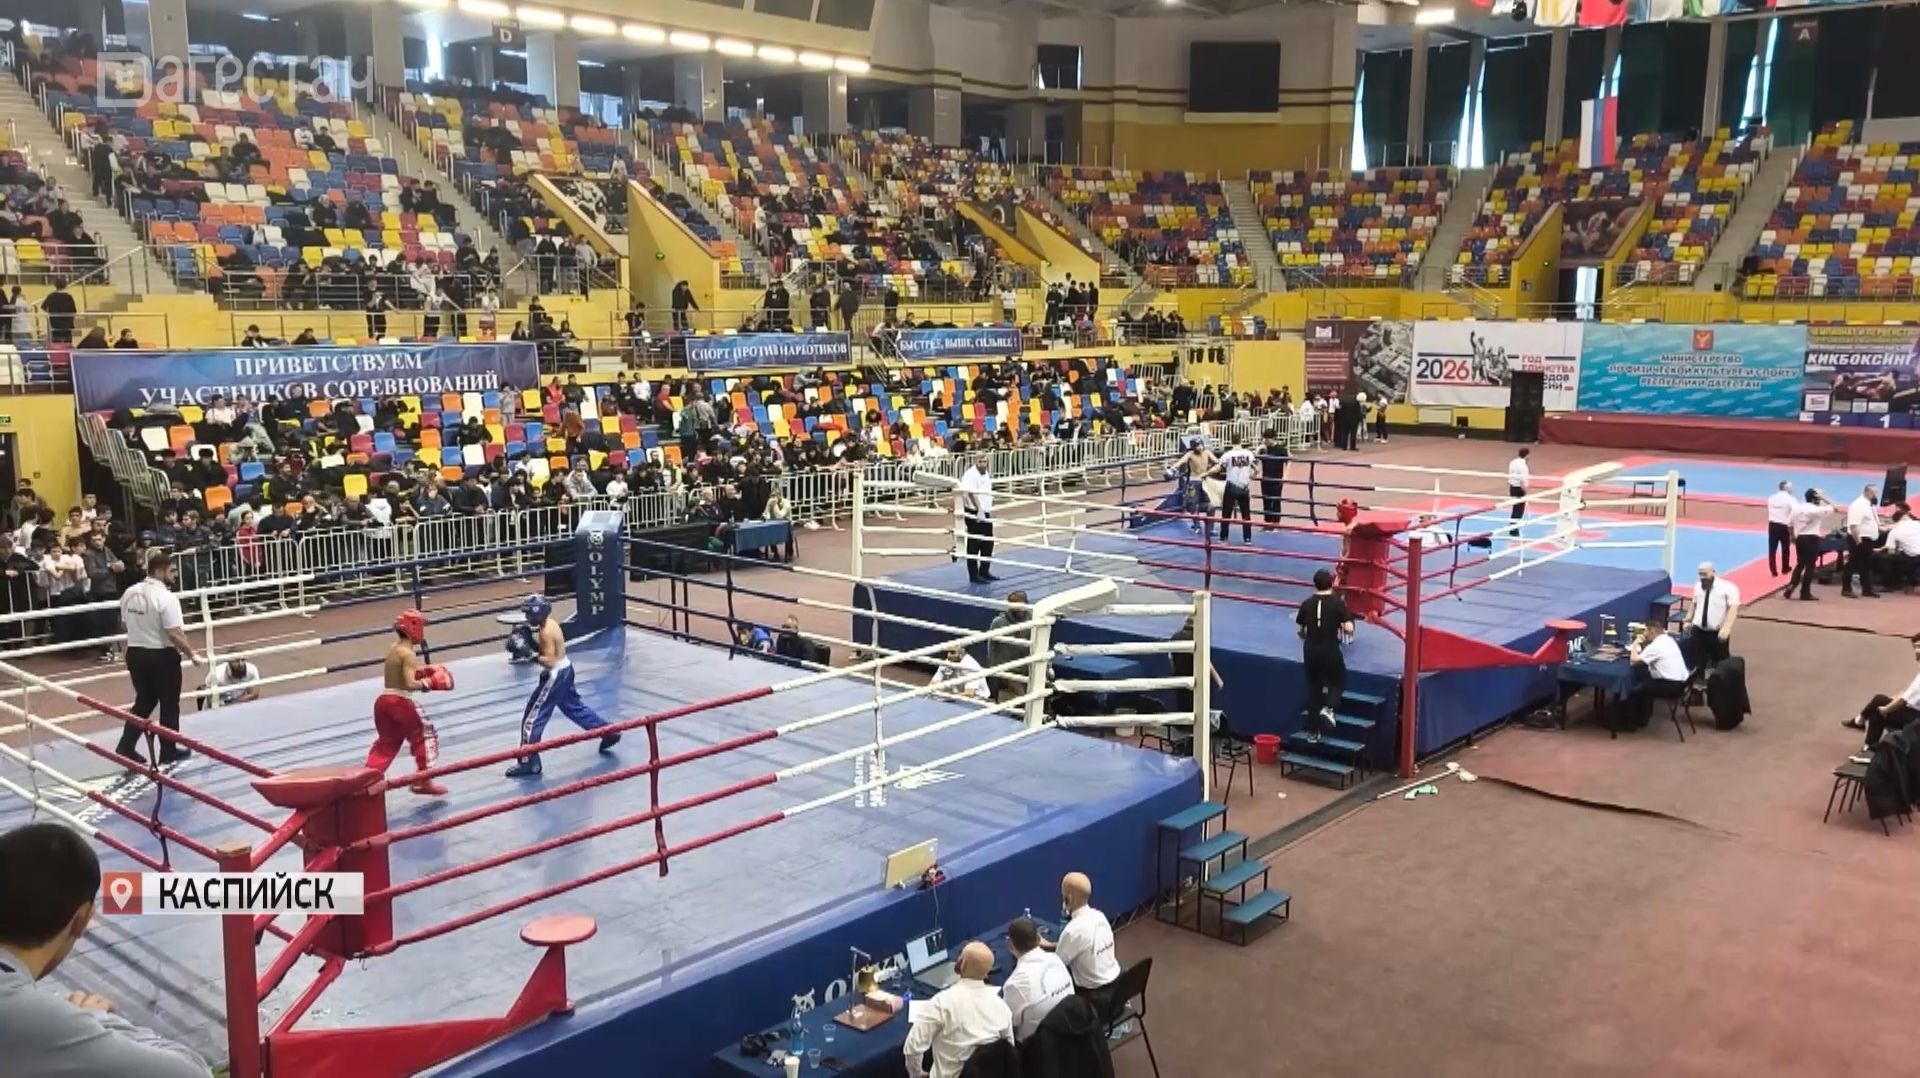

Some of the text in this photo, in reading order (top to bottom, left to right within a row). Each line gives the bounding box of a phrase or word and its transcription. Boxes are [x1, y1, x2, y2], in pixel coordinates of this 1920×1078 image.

[691, 342, 847, 361] СПОРТ ПРОТИВ НАРКОТИКОВ
[1661, 354, 1742, 364] МИНИСТЕРСТВО
[234, 352, 423, 377] ПРИВЕТСТВУЕМ
[1522, 355, 1542, 364] ГОД
[1807, 353, 1917, 366] КИКБОКСИНГ
[1416, 358, 1470, 380] 2026
[323, 370, 499, 399] СОРЕВНОВАНИЙ
[1640, 377, 1760, 389] РЕСПУБЛИКИ ДАГЕСТАН
[1830, 414, 1841, 426] 2
[1880, 414, 1890, 429] 1
[588, 551, 605, 615] OLYMP
